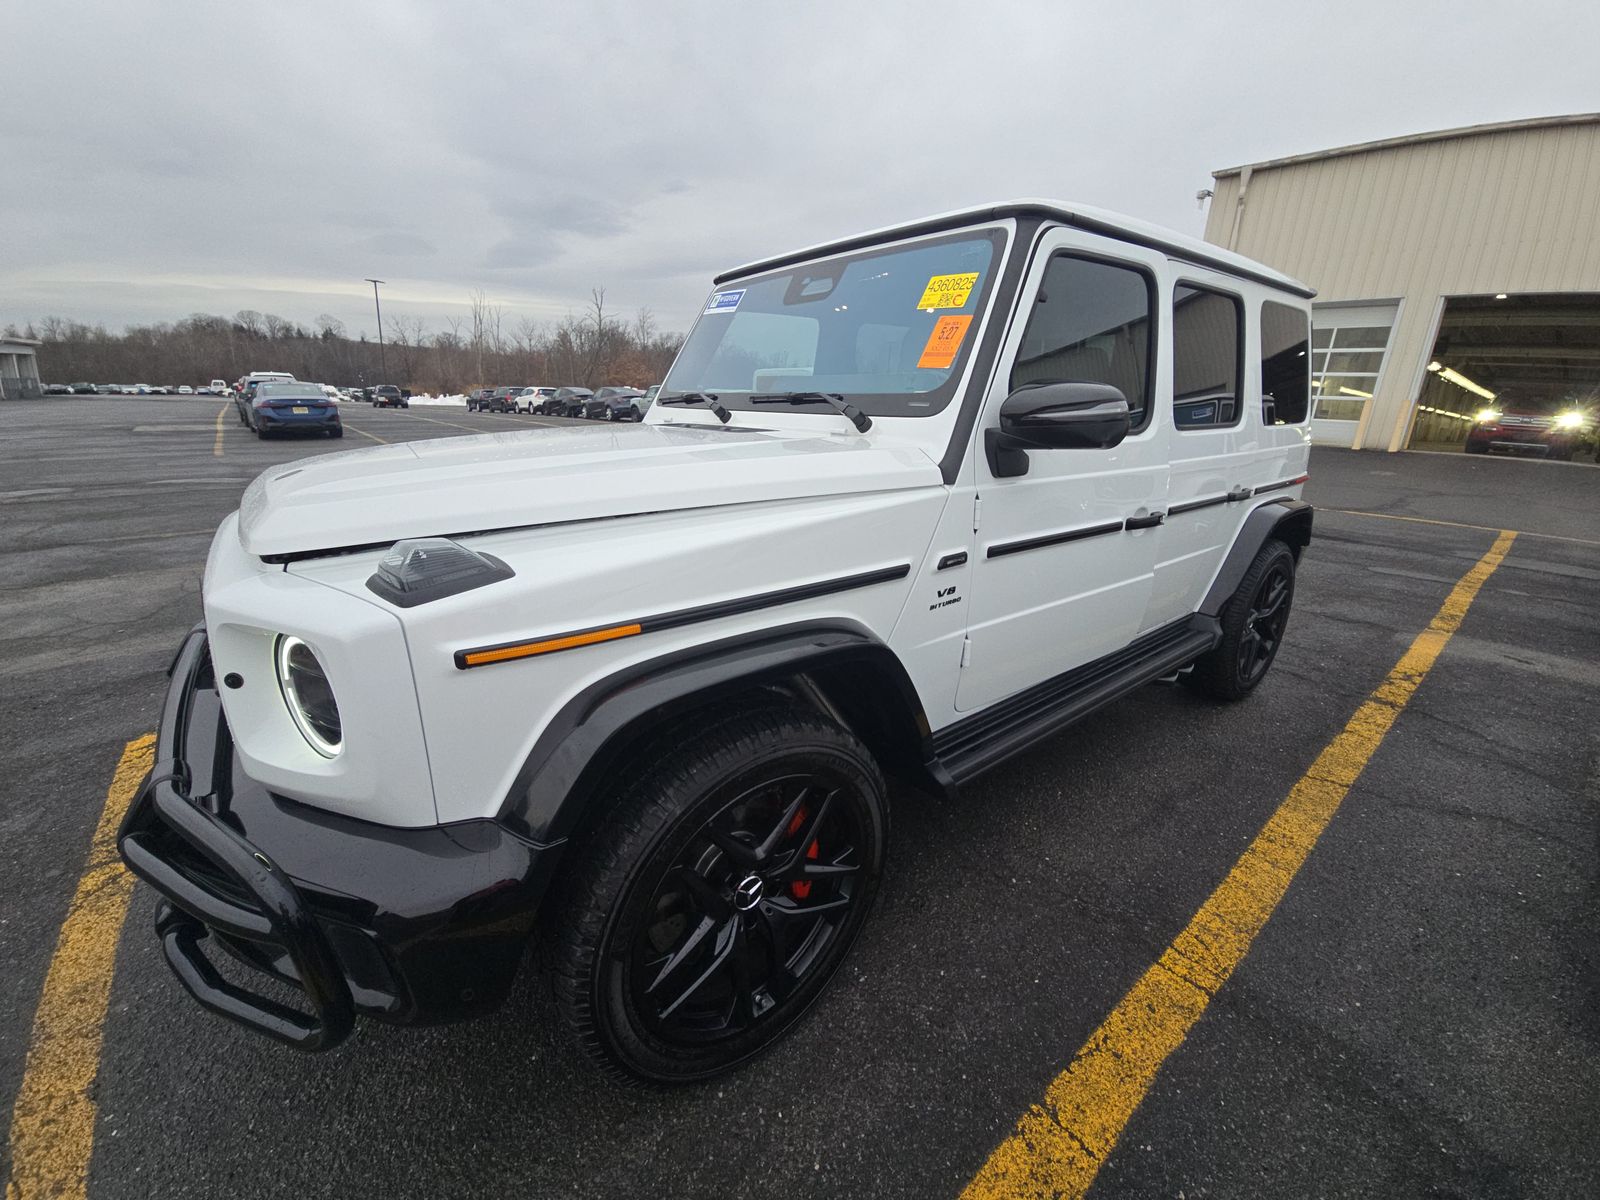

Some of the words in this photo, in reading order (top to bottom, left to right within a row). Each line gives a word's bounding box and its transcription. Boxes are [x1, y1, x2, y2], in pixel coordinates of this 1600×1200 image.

[928, 277, 976, 292] 4360825
[937, 586, 956, 598] V8
[929, 596, 962, 611] BITURBO
